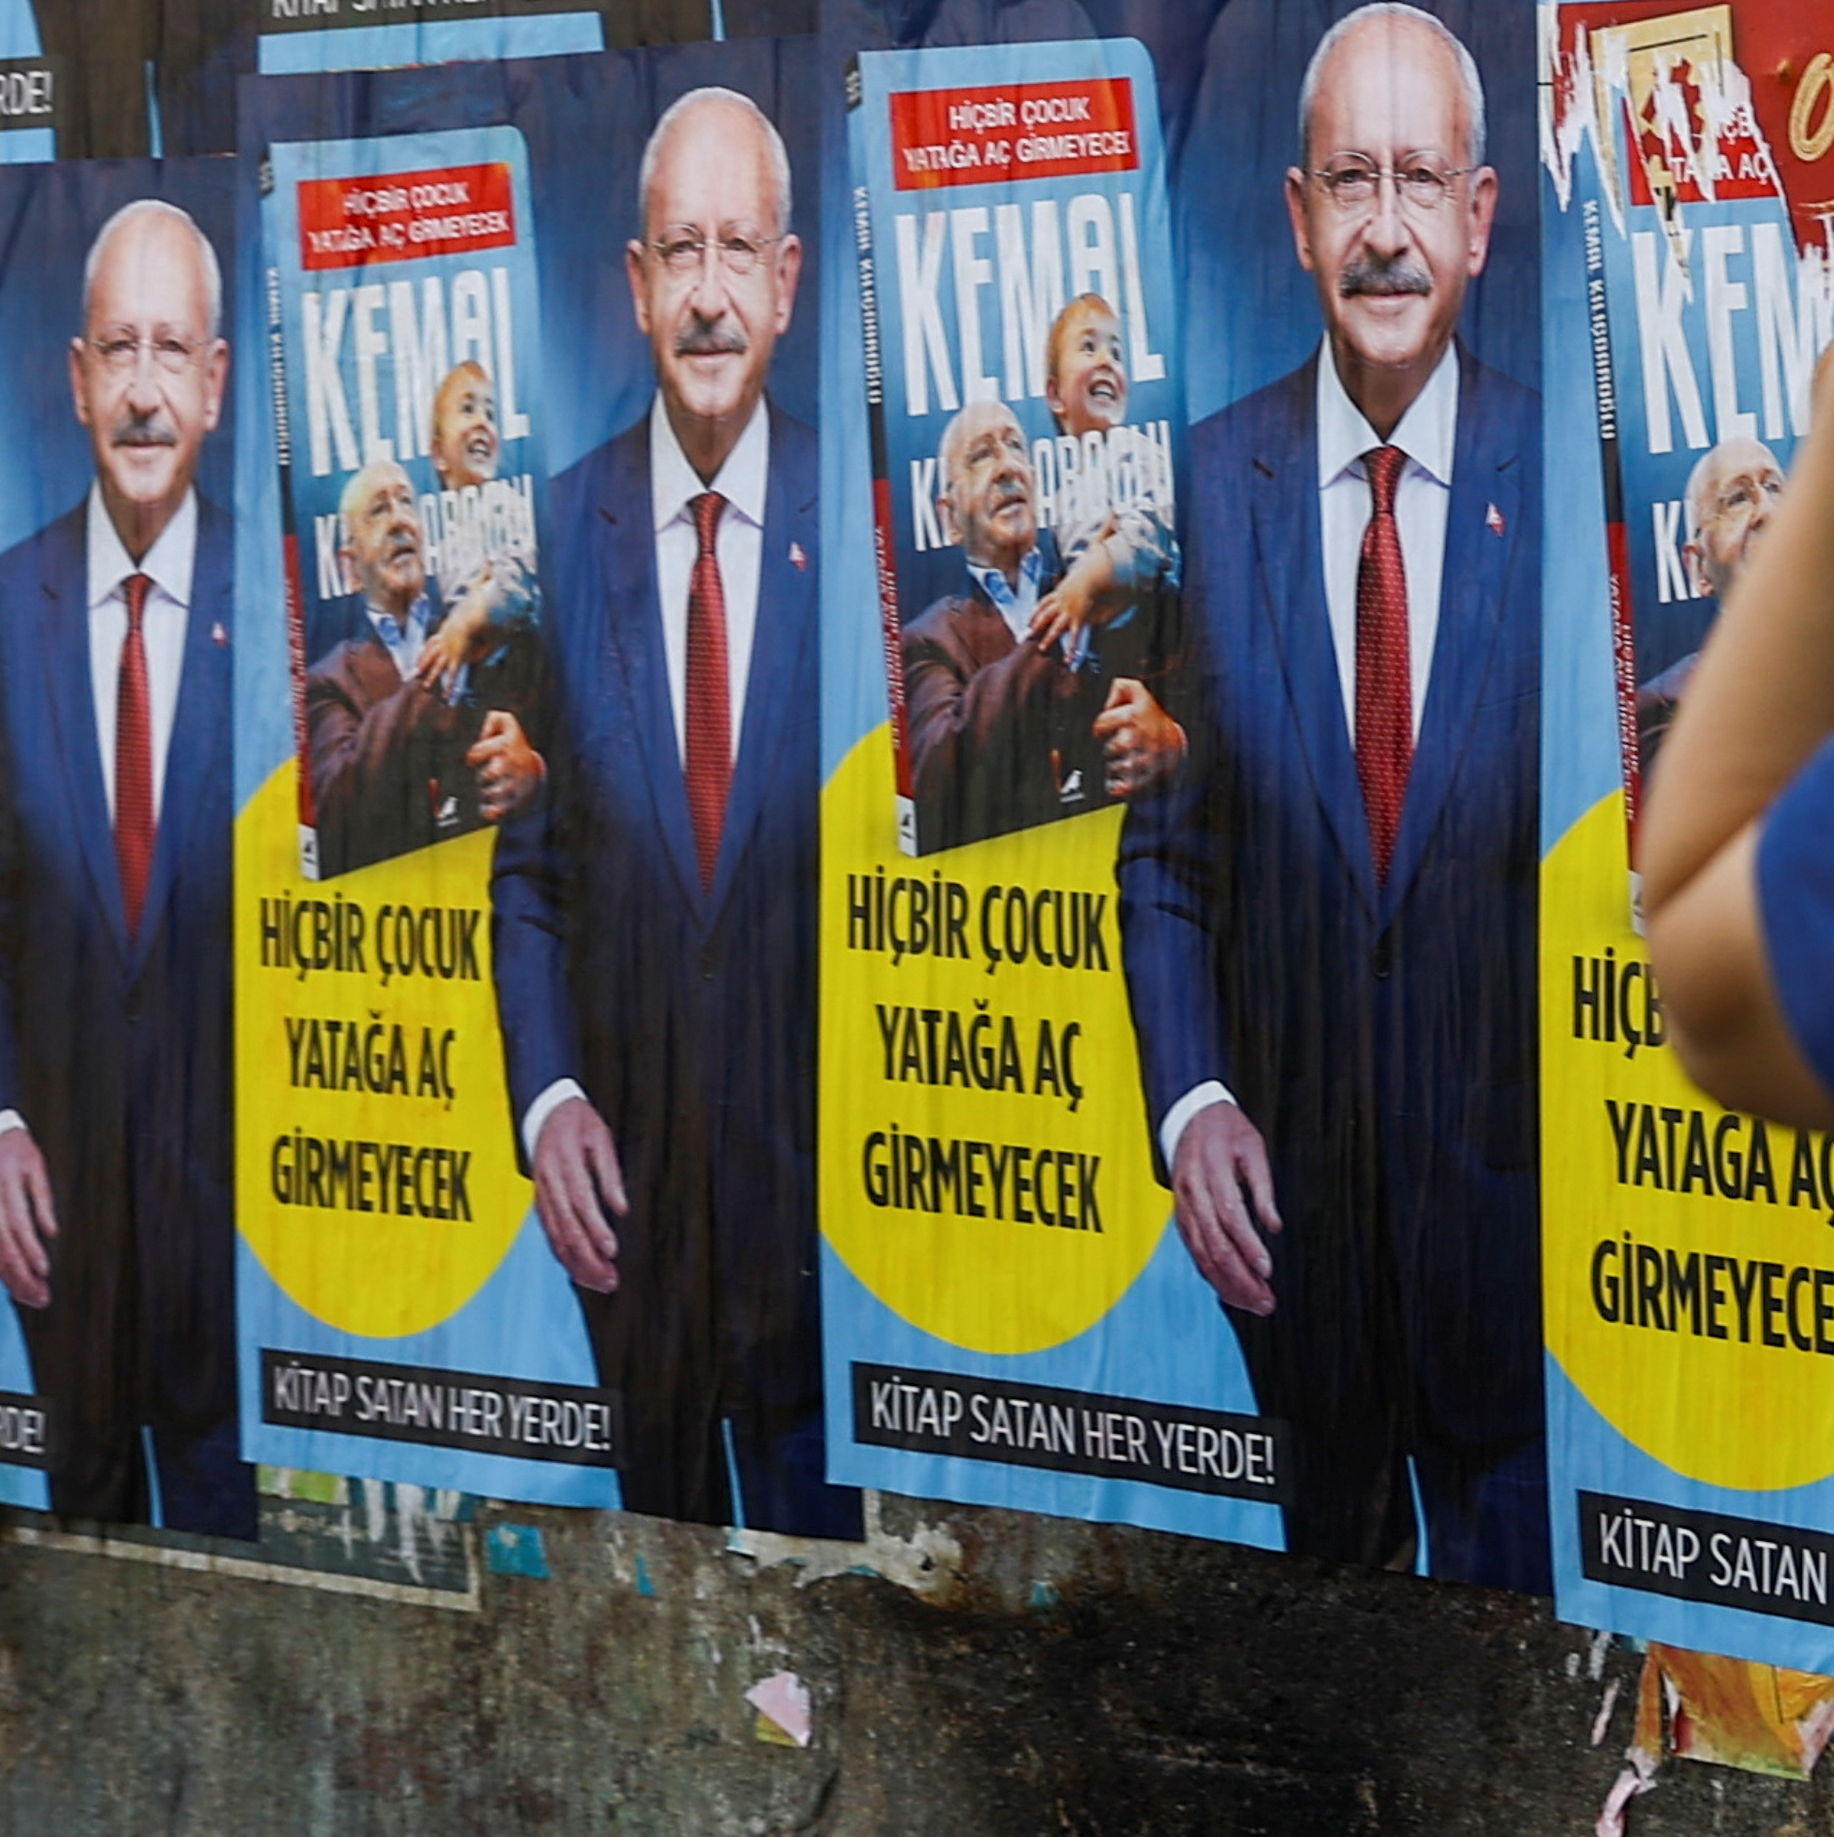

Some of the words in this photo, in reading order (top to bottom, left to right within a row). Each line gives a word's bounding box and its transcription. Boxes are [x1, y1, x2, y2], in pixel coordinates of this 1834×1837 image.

[904, 136, 981, 172] YATAĞA
[984, 144, 1011, 171] AÇ
[1015, 129, 1132, 165] GİRMEYECEK
[949, 100, 1019, 137] HİÇBİR
[1022, 96, 1090, 133] ÇOCUK
[1582, 199, 1603, 272] KEMAL
[260, 890, 367, 982] HİÇBİR
[375, 904, 481, 987] ÇOCUK
[847, 864, 971, 967] HİÇBİR
[980, 885, 1110, 976] ÇOCUK
[1572, 945, 1667, 1061] HİÇB
[284, 1010, 410, 1096] YATAĞA
[416, 1026, 455, 1111] AÇ
[875, 998, 1025, 1094] YATAĞA
[1033, 1019, 1083, 1113] AÇ
[271, 1127, 473, 1223] GİRMEYECEK
[862, 1122, 1103, 1234] GİRMEYECEK
[275, 1360, 350, 1416] KİTAP
[356, 1375, 442, 1429] SATAN
[449, 1388, 502, 1438] HER
[872, 1375, 963, 1437] KİTAP
[970, 1394, 1076, 1454] SATAN
[1082, 1410, 1150, 1465] HER
[1600, 1508, 1700, 1579] KİTAP
[1710, 1533, 1827, 1605] SATAN
